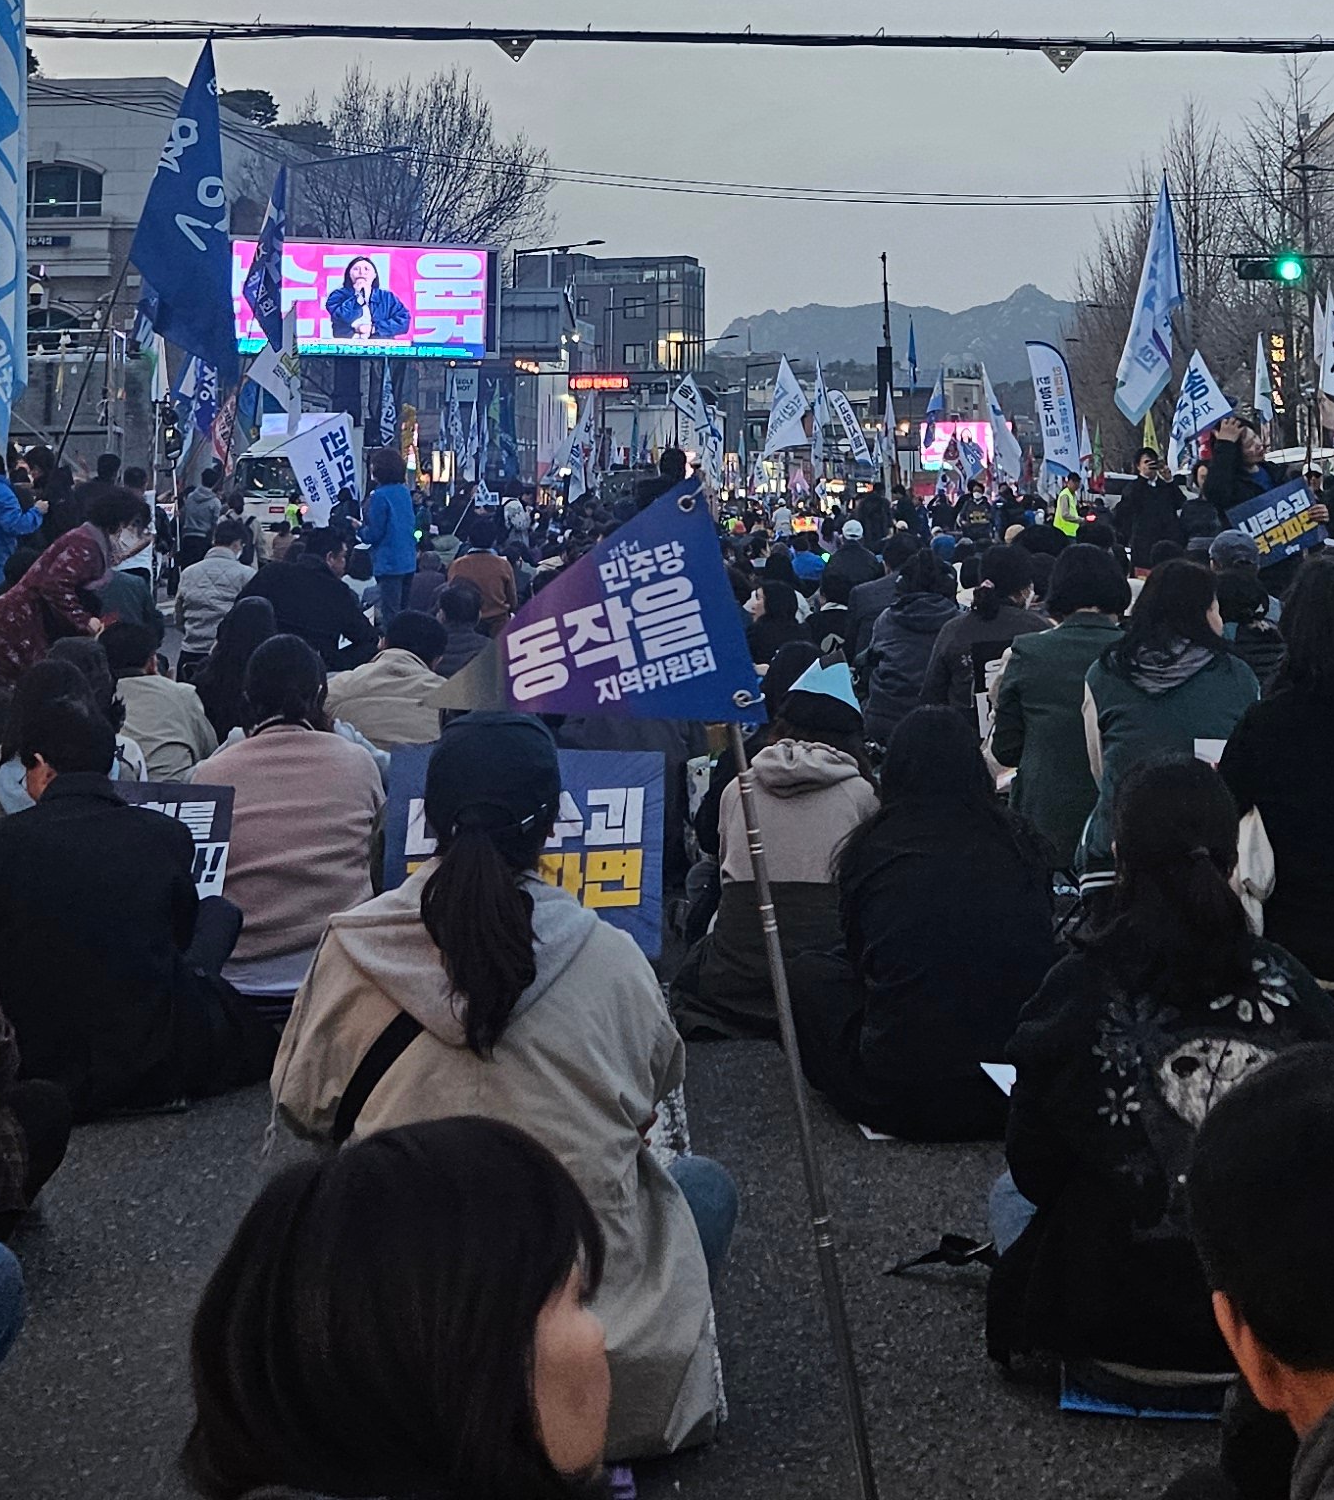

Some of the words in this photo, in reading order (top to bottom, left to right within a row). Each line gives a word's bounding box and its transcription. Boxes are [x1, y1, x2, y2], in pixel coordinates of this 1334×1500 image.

[598, 540, 686, 594] 민주당
[506, 575, 710, 701] 동작을
[593, 646, 718, 704] 지역위원회
